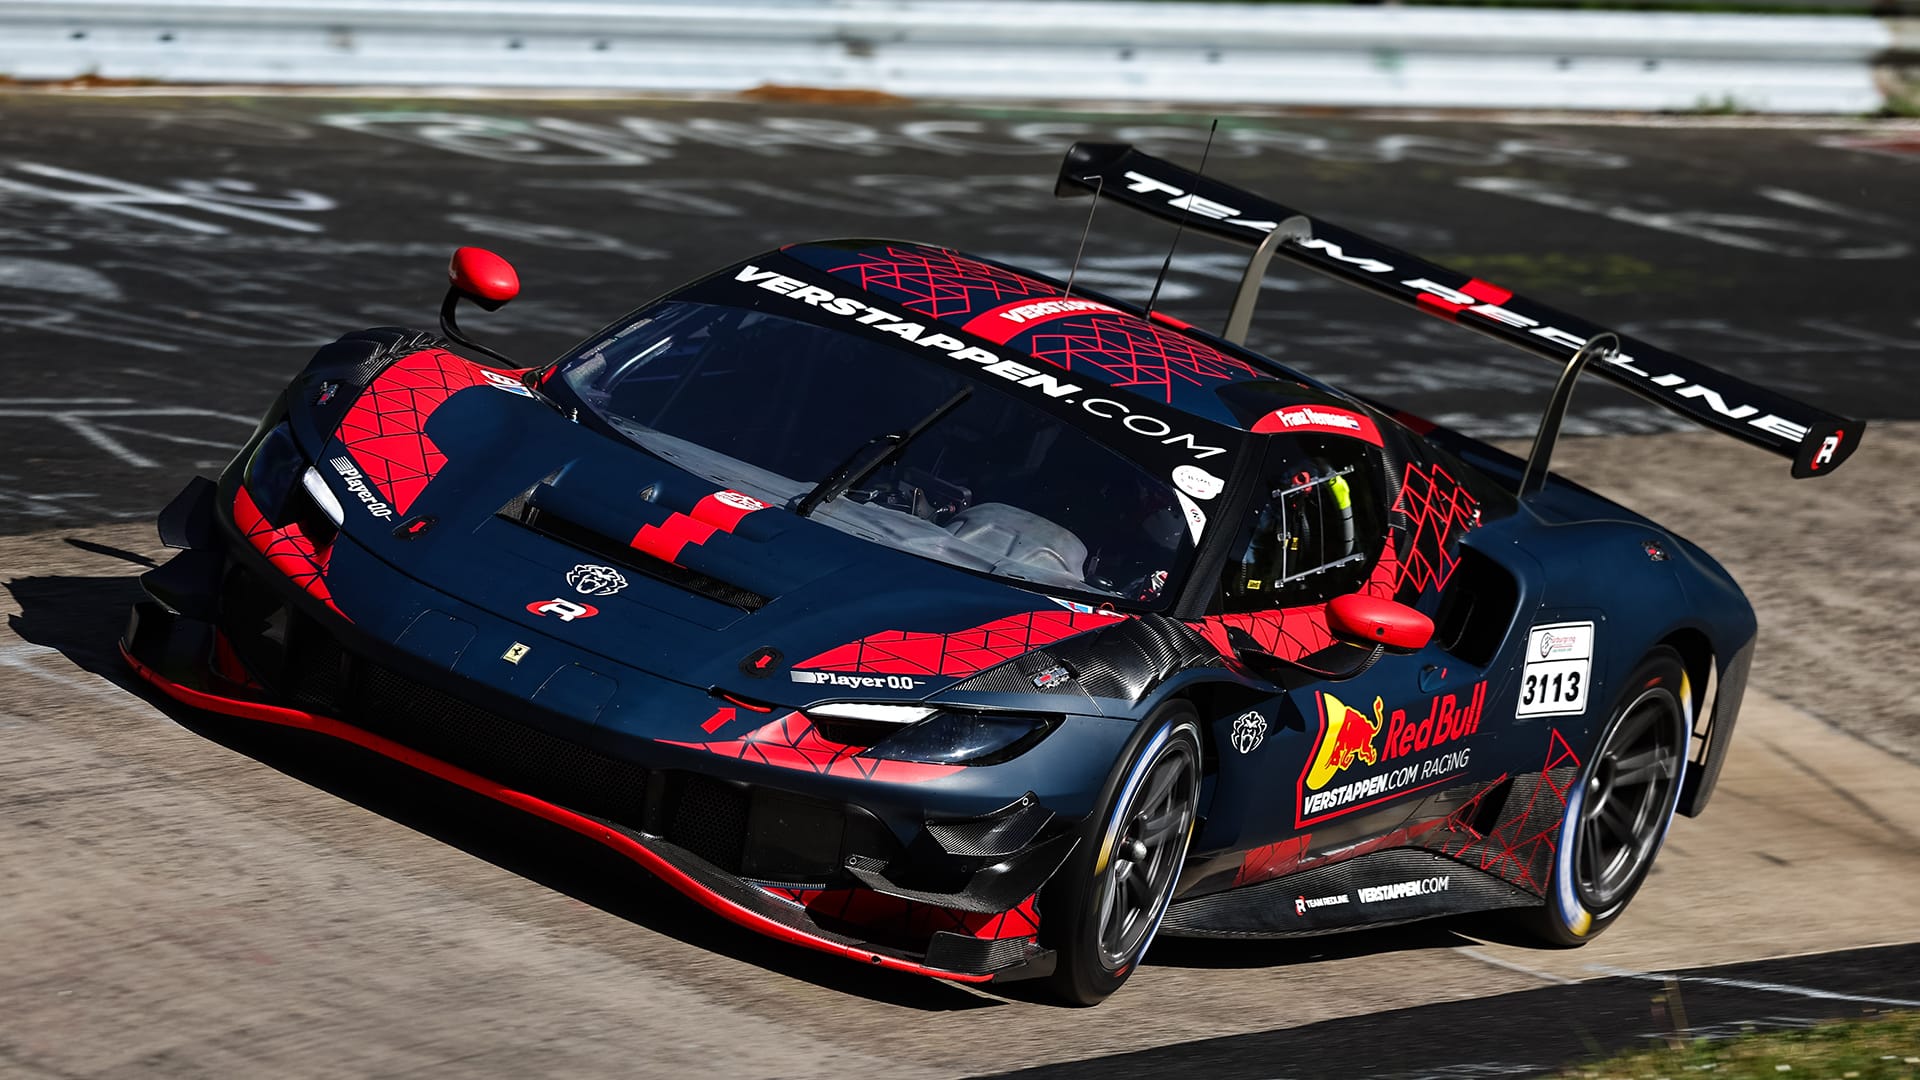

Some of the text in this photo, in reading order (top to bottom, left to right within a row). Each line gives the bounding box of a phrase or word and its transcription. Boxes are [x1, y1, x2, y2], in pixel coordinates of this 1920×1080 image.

[1124, 170, 1395, 273] TEAM
[734, 264, 1228, 460] VERSTAPPEN.COM
[339, 467, 378, 503] Player
[813, 672, 887, 689] Player
[1522, 671, 1581, 706] 3113
[1381, 680, 1488, 762] Red Bull
[1304, 748, 1471, 815] VERSTAPPEN.COM RACING
[1305, 898, 1325, 909] TEAM
[1323, 894, 1350, 906] REDLINE
[1357, 875, 1450, 904] VERSTAPPEN.COM
